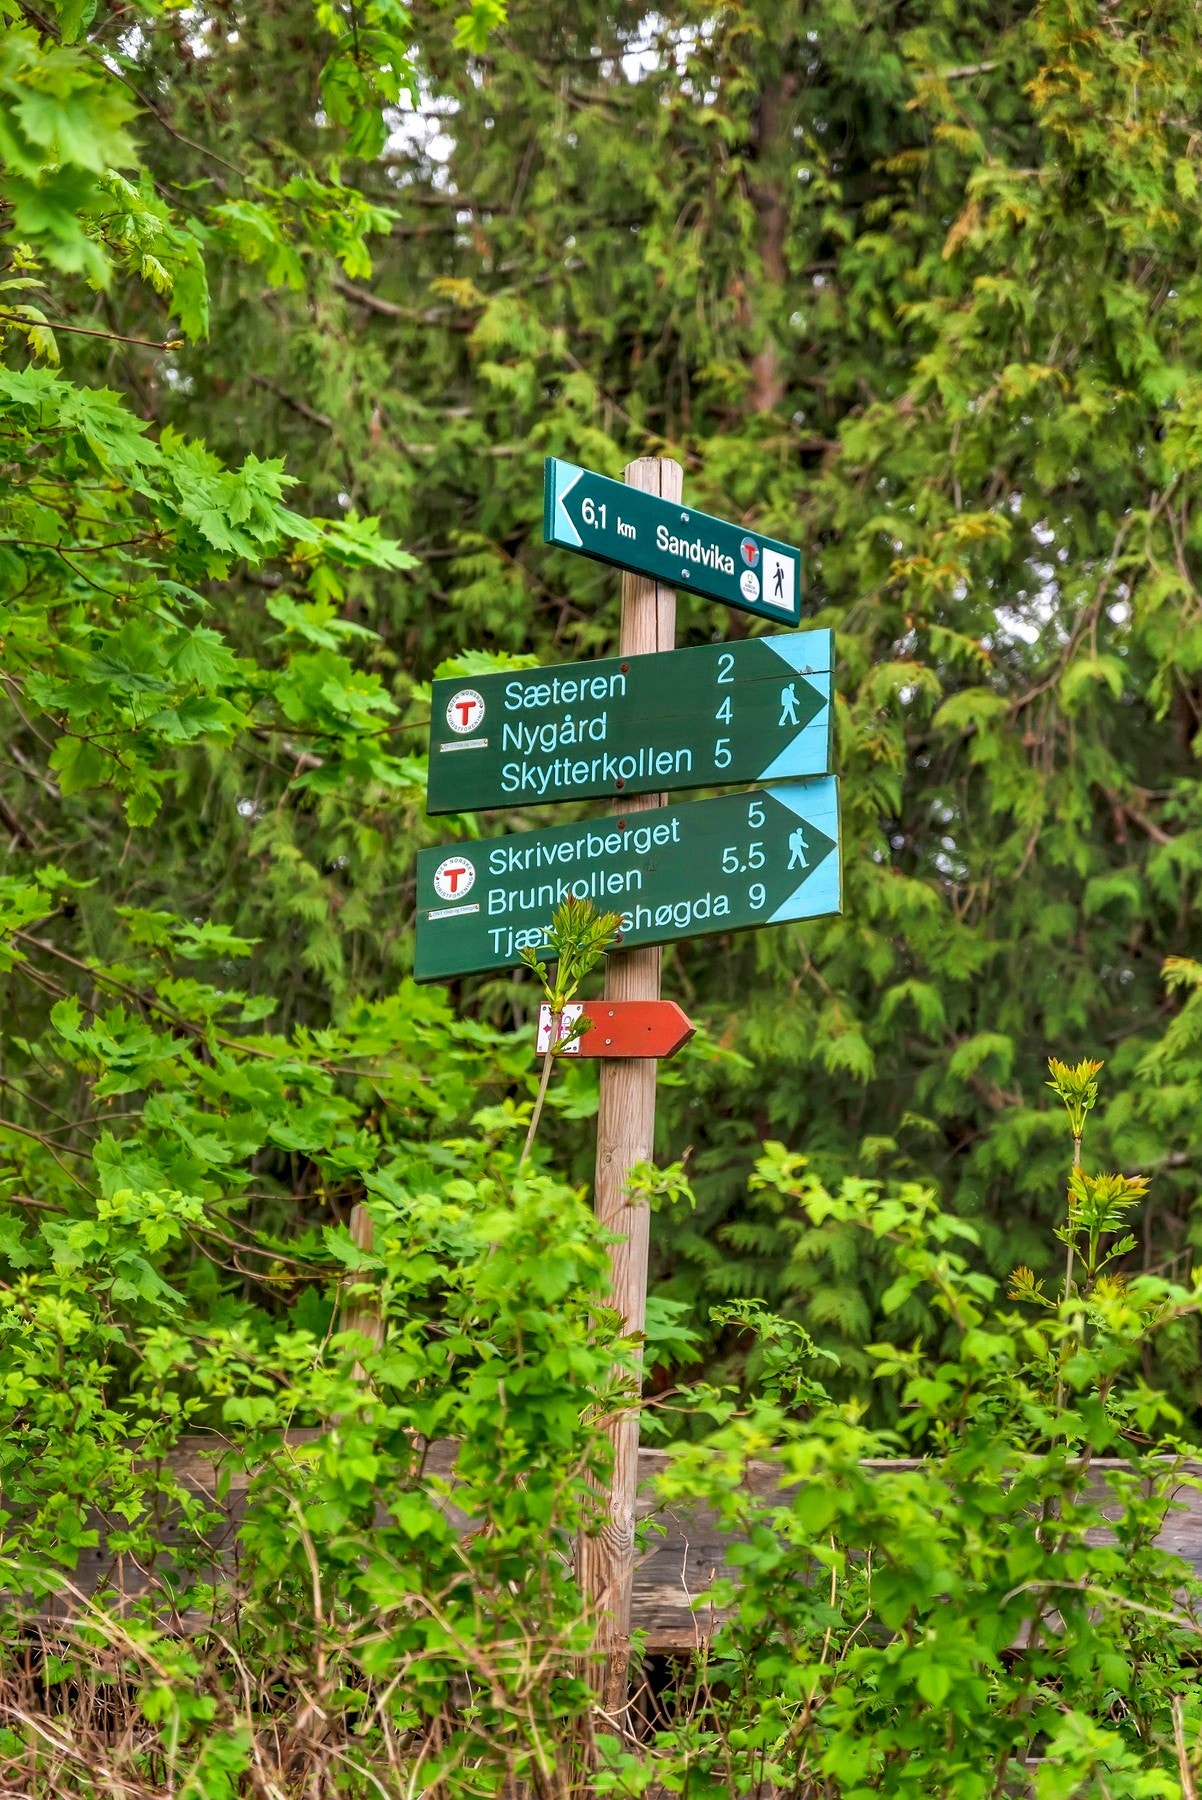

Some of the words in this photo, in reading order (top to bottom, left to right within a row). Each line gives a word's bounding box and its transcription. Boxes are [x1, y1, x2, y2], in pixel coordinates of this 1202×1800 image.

[581, 498, 606, 530] 6,1
[617, 516, 637, 540] km
[656, 525, 735, 575] Sandvika
[504, 673, 626, 710] Sæteren
[717, 653, 735, 684] 2
[455, 701, 476, 726] T
[502, 711, 607, 755] Nygård
[715, 696, 733, 725] 4
[501, 747, 692, 795] Skytterkollen
[714, 738, 732, 768] 5
[488, 817, 680, 875] Skriverberget
[748, 801, 766, 828] 5
[444, 868, 466, 892] T
[488, 869, 642, 915] Brunkollen
[722, 842, 766, 873] 5,5
[487, 892, 730, 957] Tjærshøgda
[749, 883, 767, 910] 9
